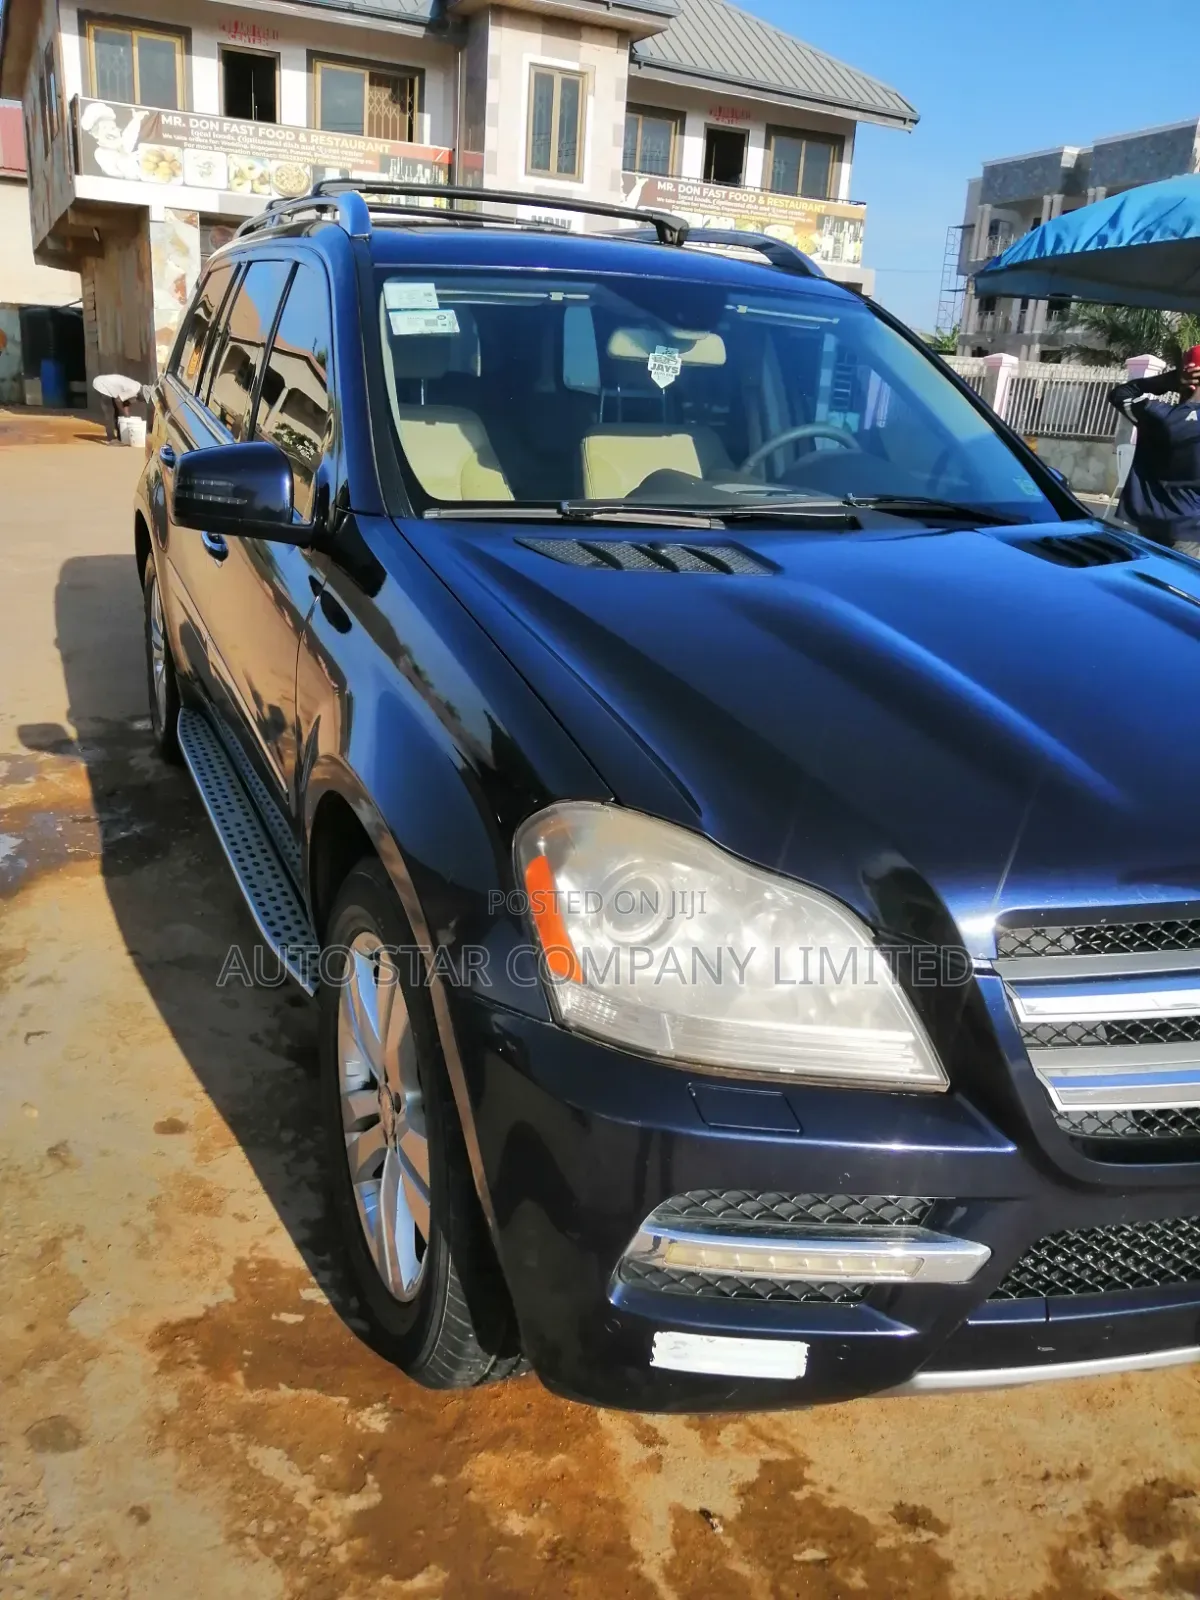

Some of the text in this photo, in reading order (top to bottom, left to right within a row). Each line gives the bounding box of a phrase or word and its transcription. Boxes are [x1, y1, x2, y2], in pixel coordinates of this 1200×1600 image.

[161, 114, 391, 153] MR. DON FAST FOOD & RESTAURANT
[657, 181, 826, 213] MR. DON FAST FOOD & RESTAURANT
[651, 363, 679, 374] JAYS
